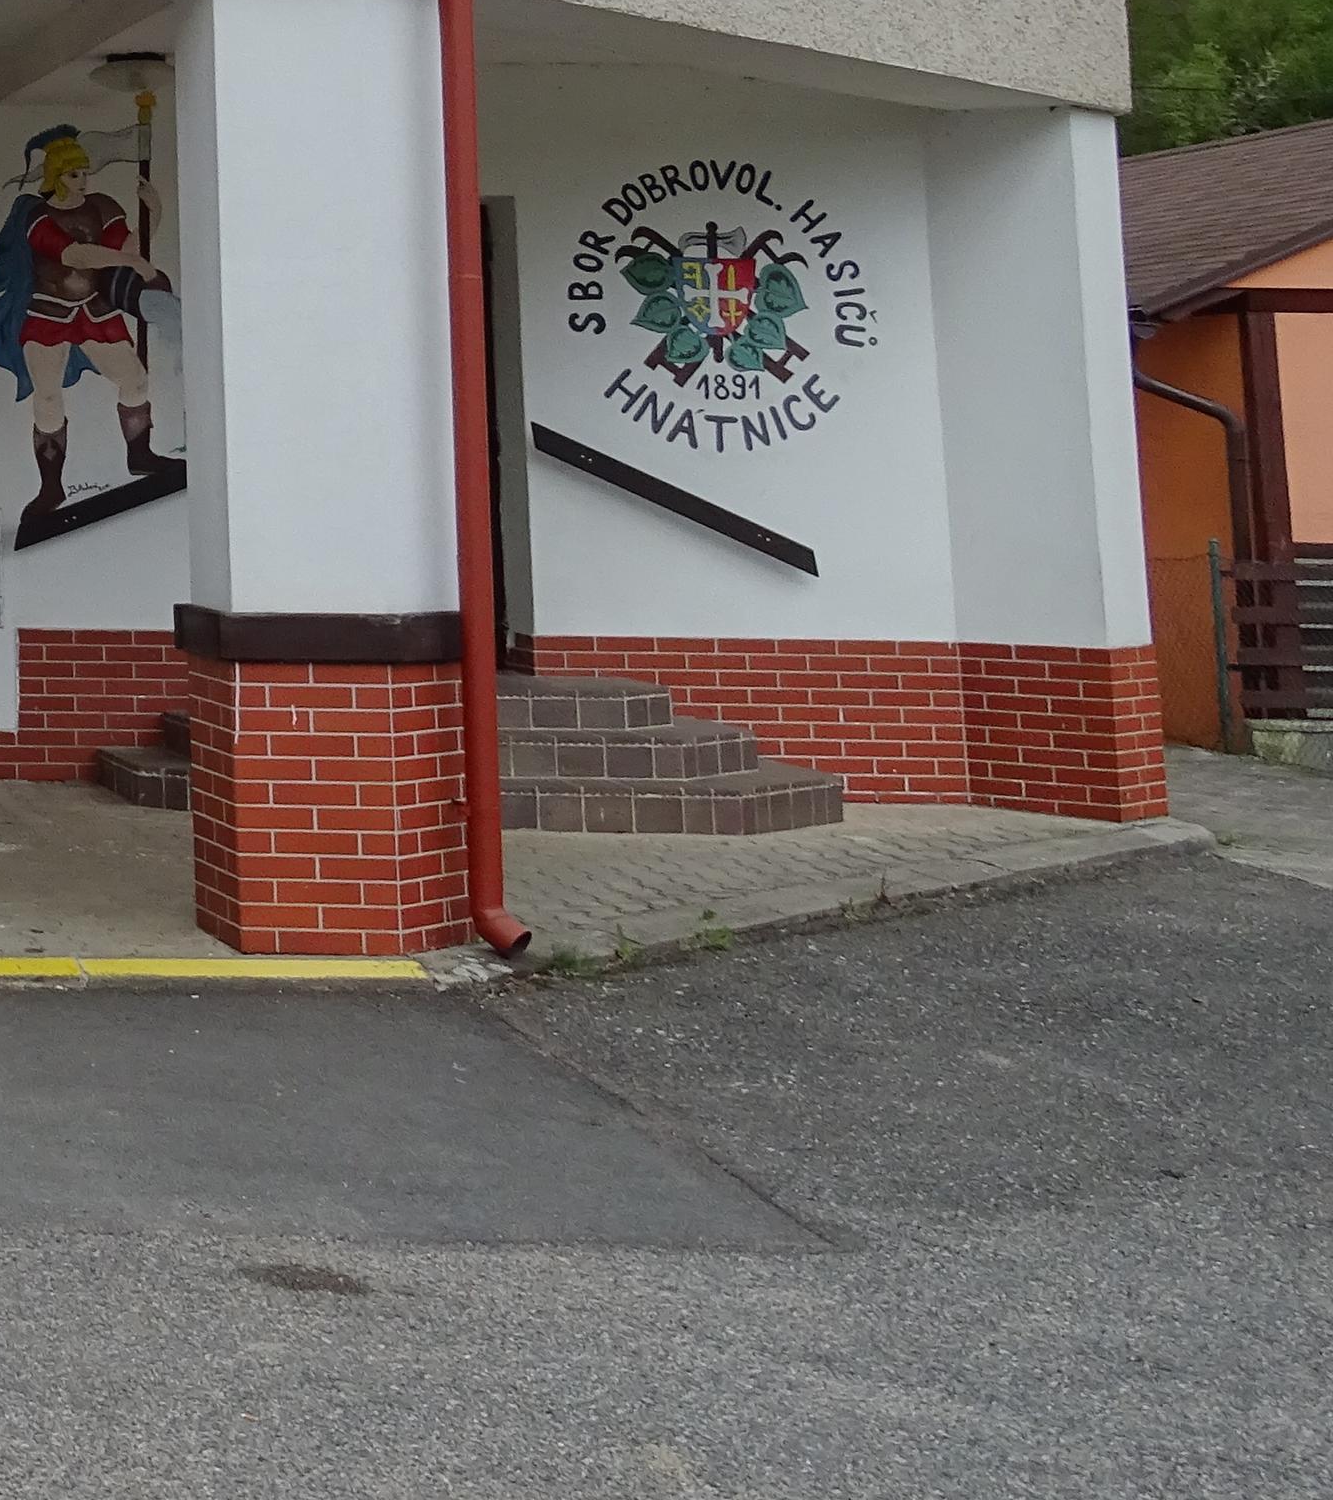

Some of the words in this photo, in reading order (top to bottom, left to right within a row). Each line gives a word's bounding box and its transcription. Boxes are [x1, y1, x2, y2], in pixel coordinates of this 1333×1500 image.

[567, 229, 616, 335] SBOR
[601, 159, 783, 227] DOBROVOL.
[789, 199, 878, 348] HASIČŮ
[602, 367, 841, 454] HNÁTNICE
[695, 373, 761, 401] 1891
